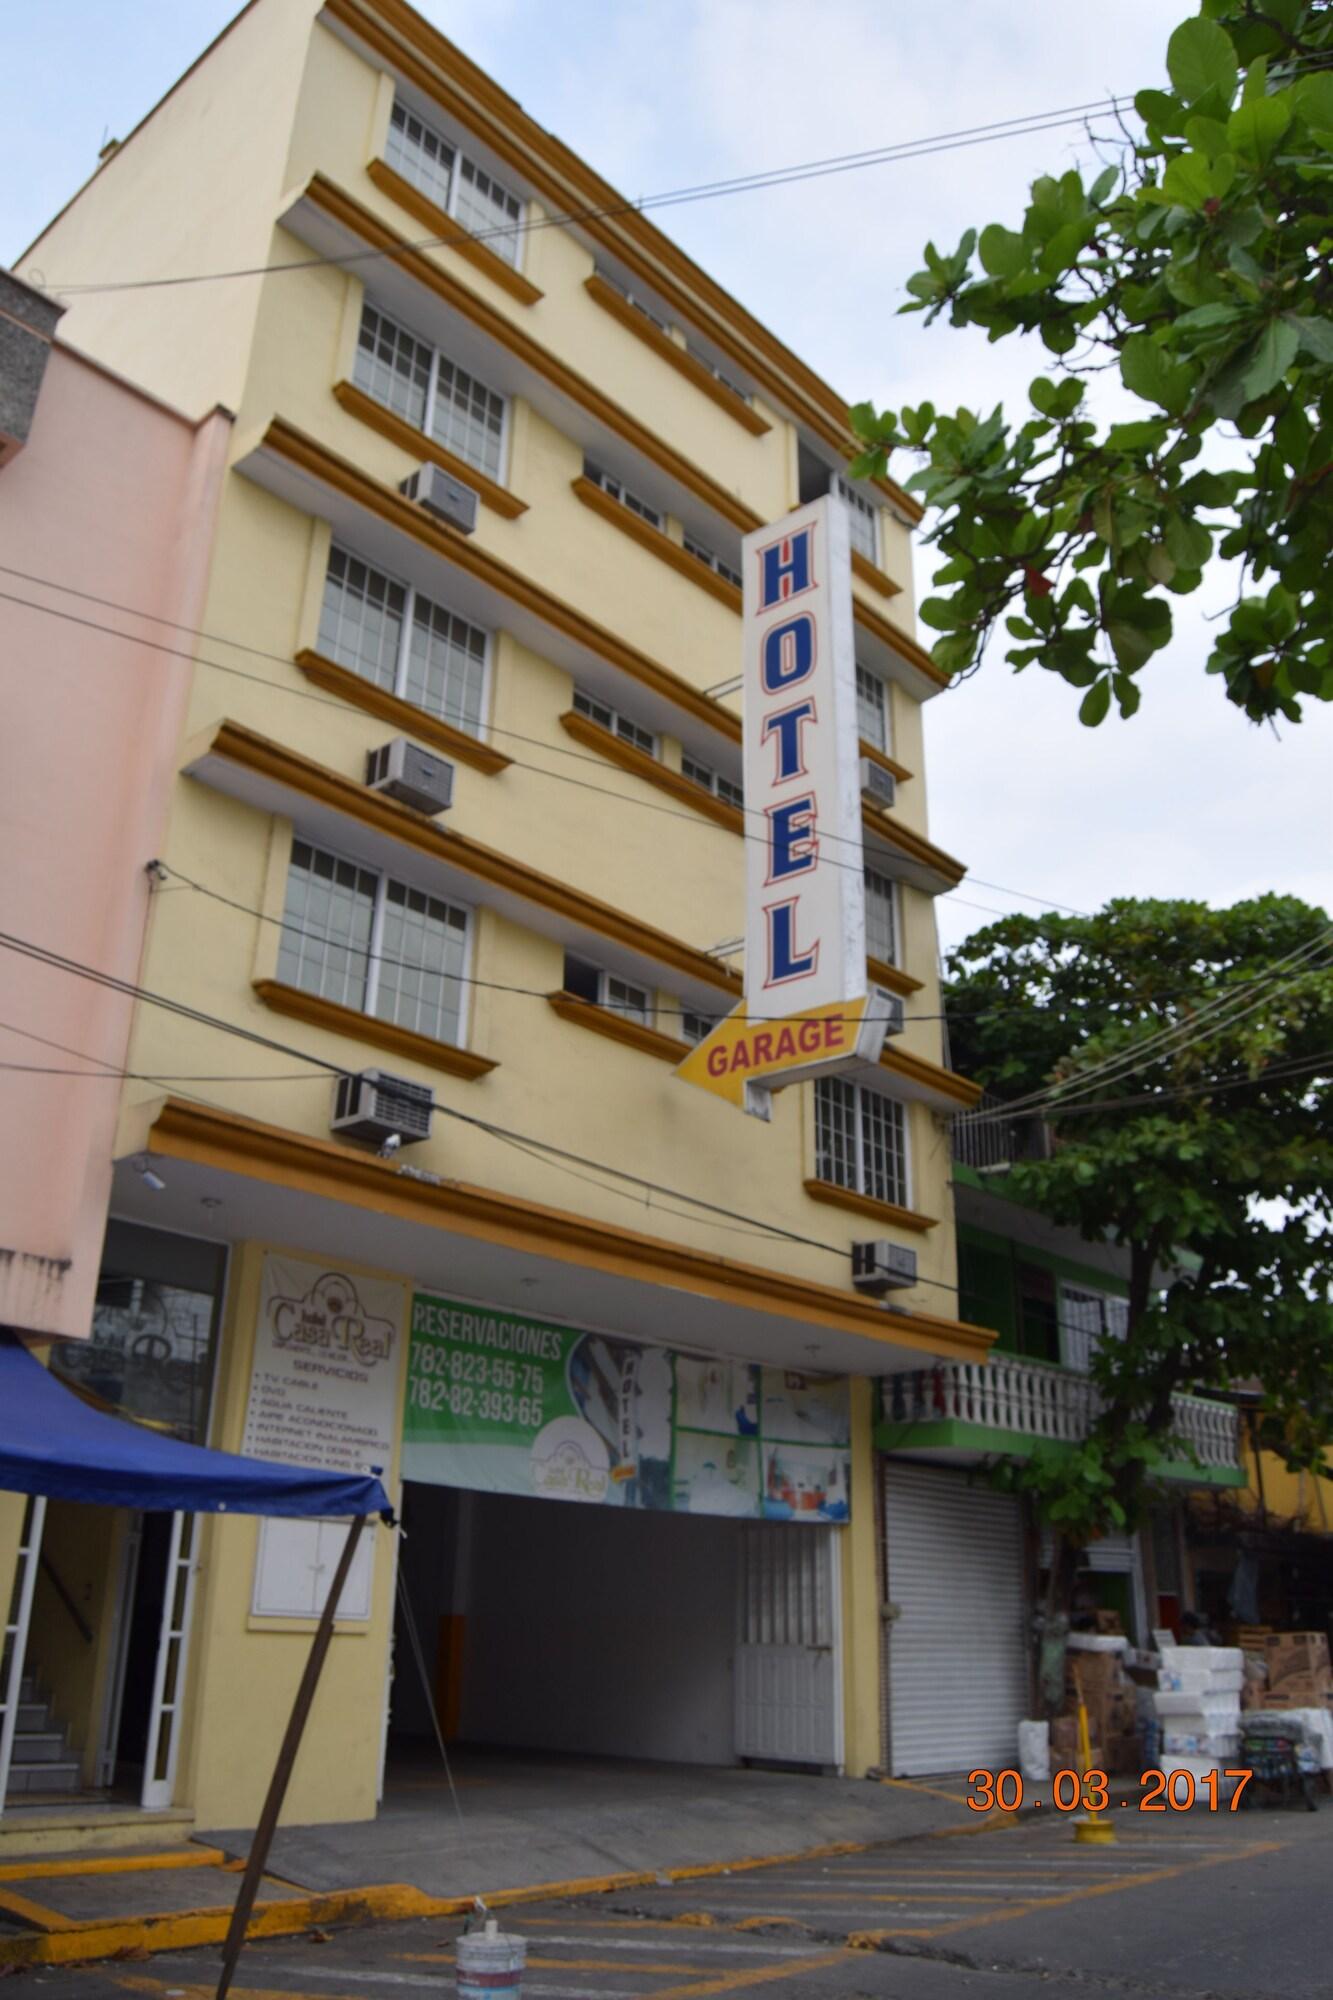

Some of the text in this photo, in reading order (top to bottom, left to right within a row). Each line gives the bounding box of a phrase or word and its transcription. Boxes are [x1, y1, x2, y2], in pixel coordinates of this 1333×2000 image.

[756, 521, 821, 990] HOTEL
[706, 1013, 846, 1078] GARAGE
[272, 1302, 330, 1348] Casa
[332, 1316, 391, 1366] Real
[413, 1302, 562, 1361] RESERVACIONES
[293, 1359, 369, 1383] SERVICIOS
